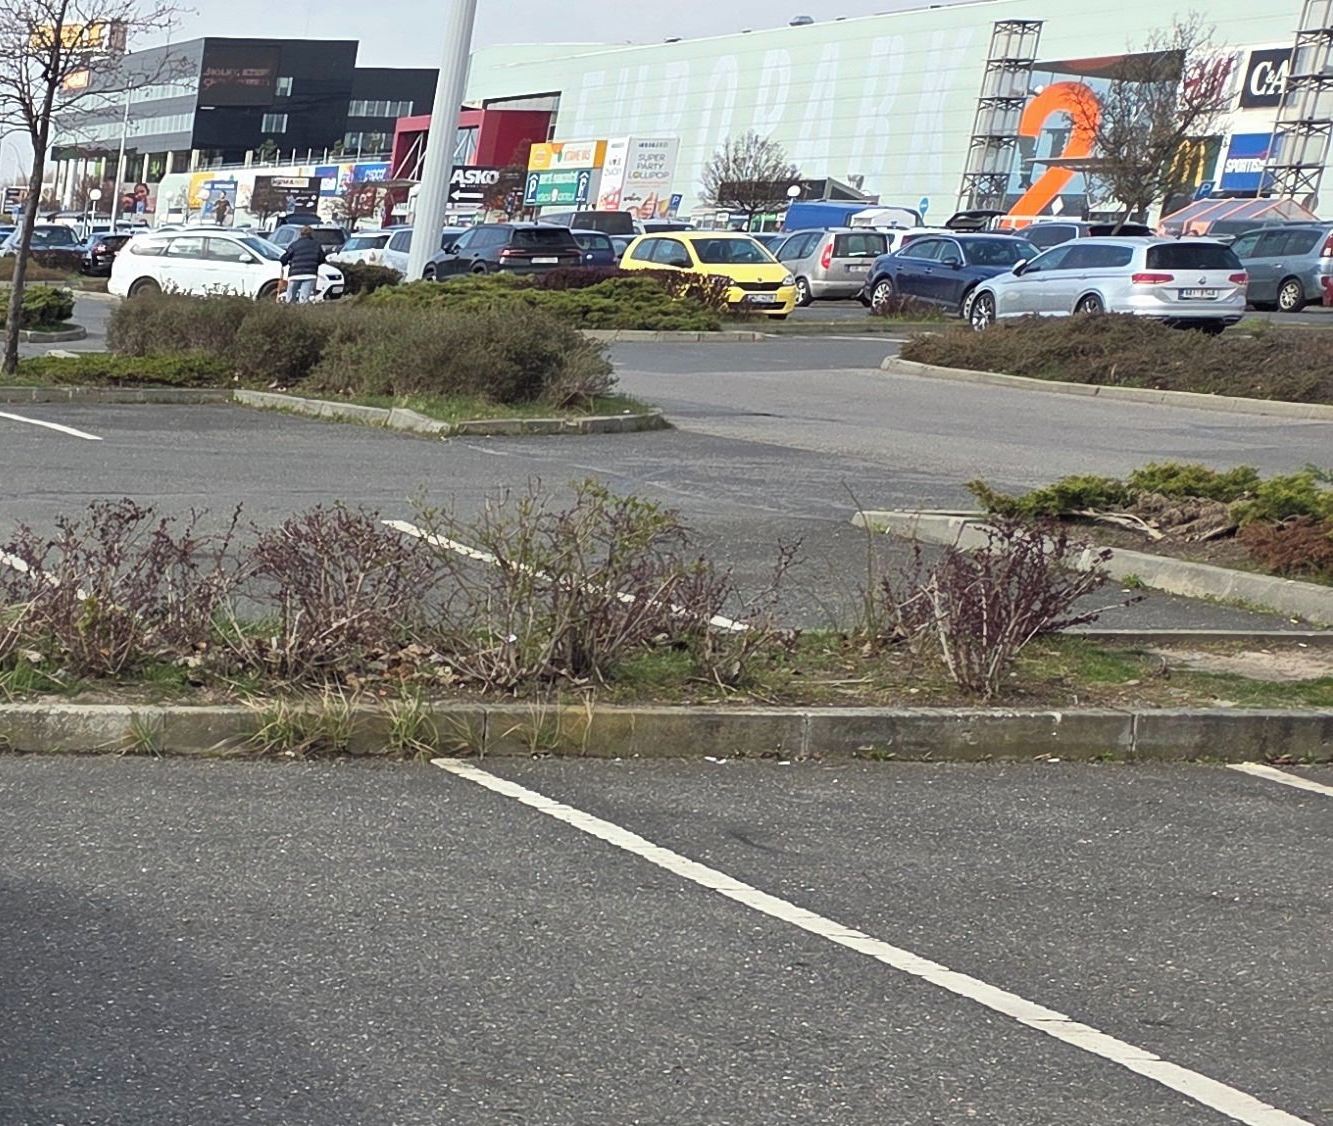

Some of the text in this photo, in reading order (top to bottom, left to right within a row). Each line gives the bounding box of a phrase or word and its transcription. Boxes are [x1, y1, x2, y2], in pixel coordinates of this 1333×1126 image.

[1250, 59, 1290, 96] C&A
[1225, 157, 1277, 174] SPORTIS
[450, 169, 500, 184] ASKO
